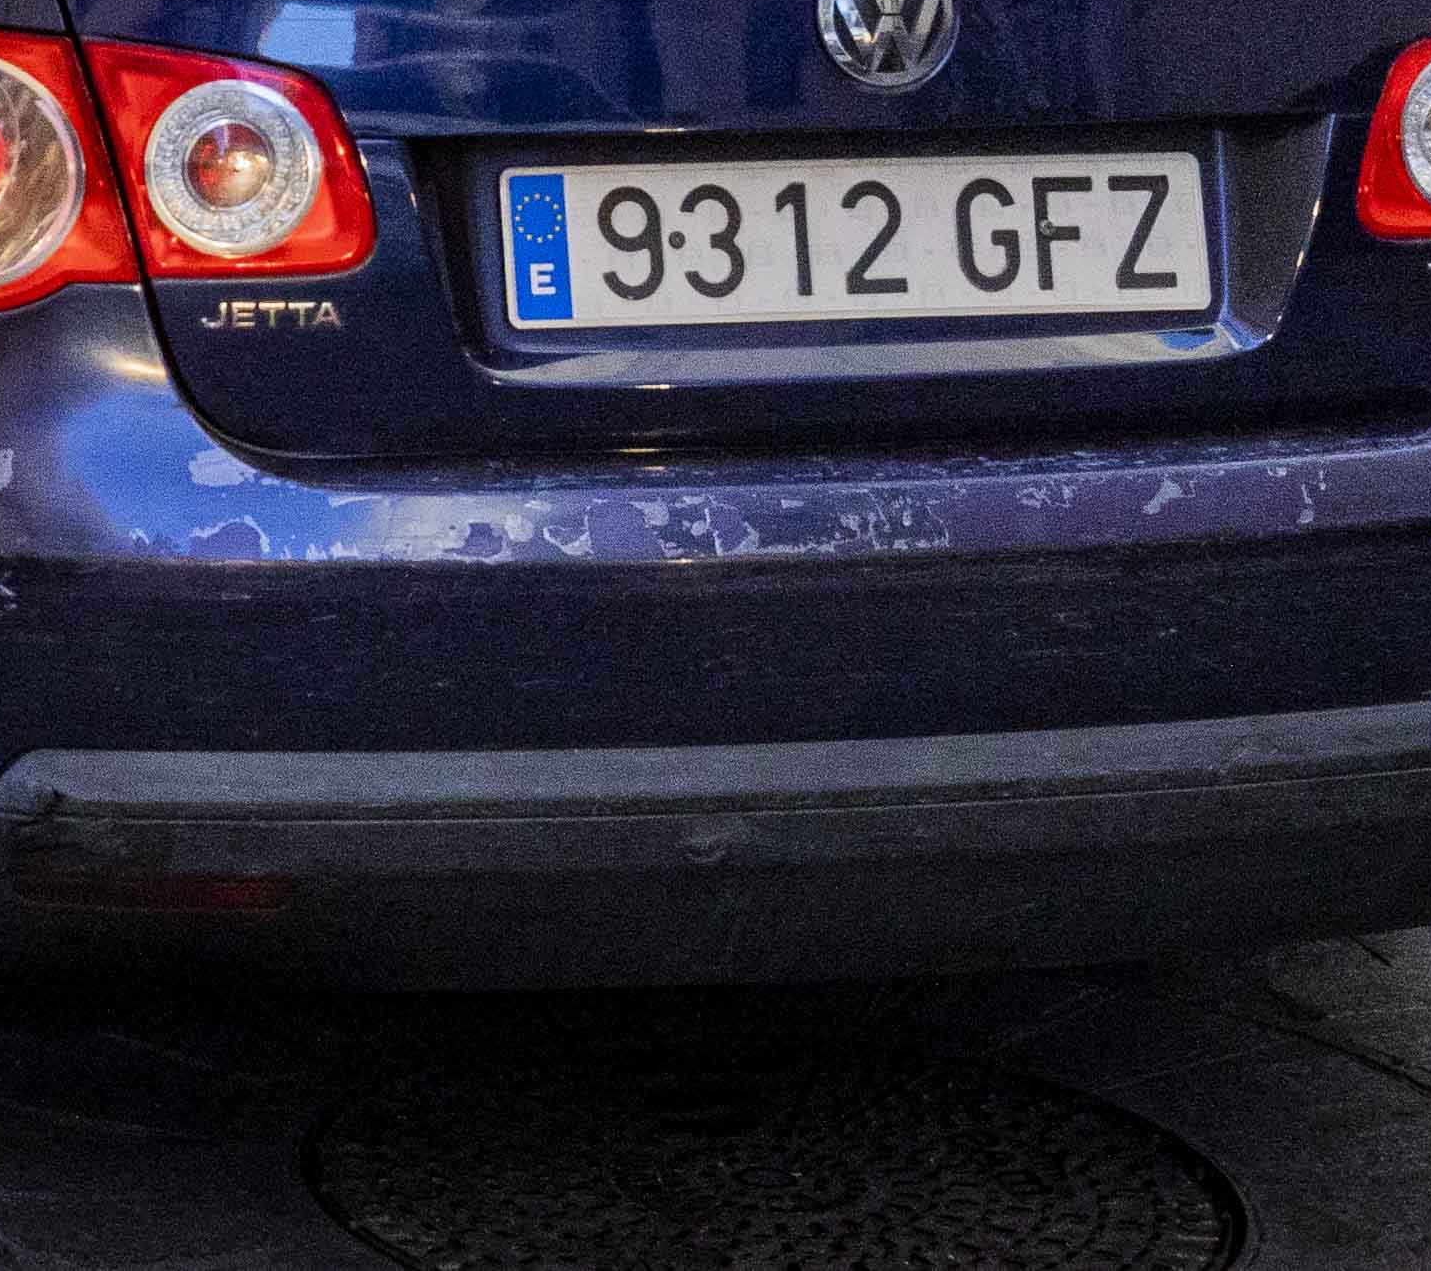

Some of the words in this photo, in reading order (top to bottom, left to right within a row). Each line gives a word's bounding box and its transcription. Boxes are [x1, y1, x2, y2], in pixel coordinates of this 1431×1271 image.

[596, 179, 909, 302] 9312
[955, 174, 1178, 294] GFZ
[528, 261, 558, 296] E
[200, 301, 341, 329] JETTA
